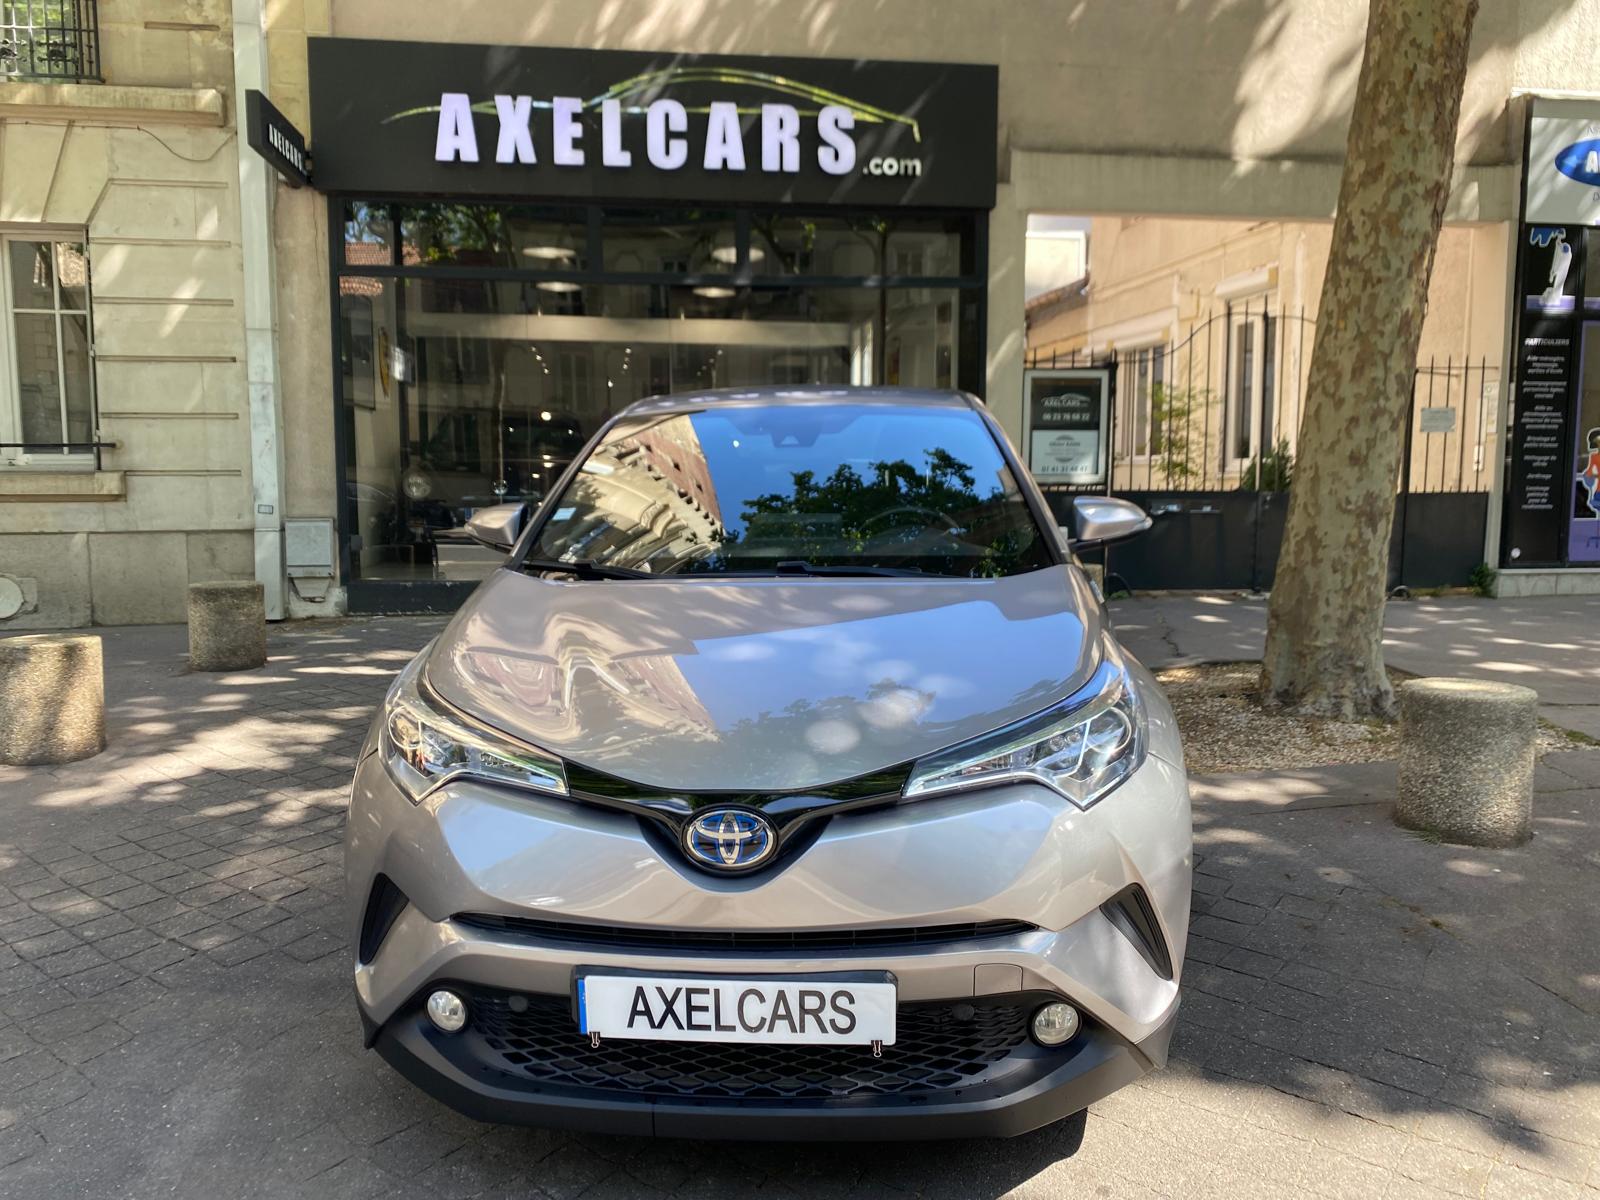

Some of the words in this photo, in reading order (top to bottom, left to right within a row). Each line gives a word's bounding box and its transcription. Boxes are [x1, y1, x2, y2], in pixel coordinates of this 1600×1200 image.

[435, 92, 857, 176] AXELCARS
[863, 156, 921, 177] .com
[1524, 337, 1570, 346] PARTICULIERS
[627, 985, 858, 1035] AXELCARS
